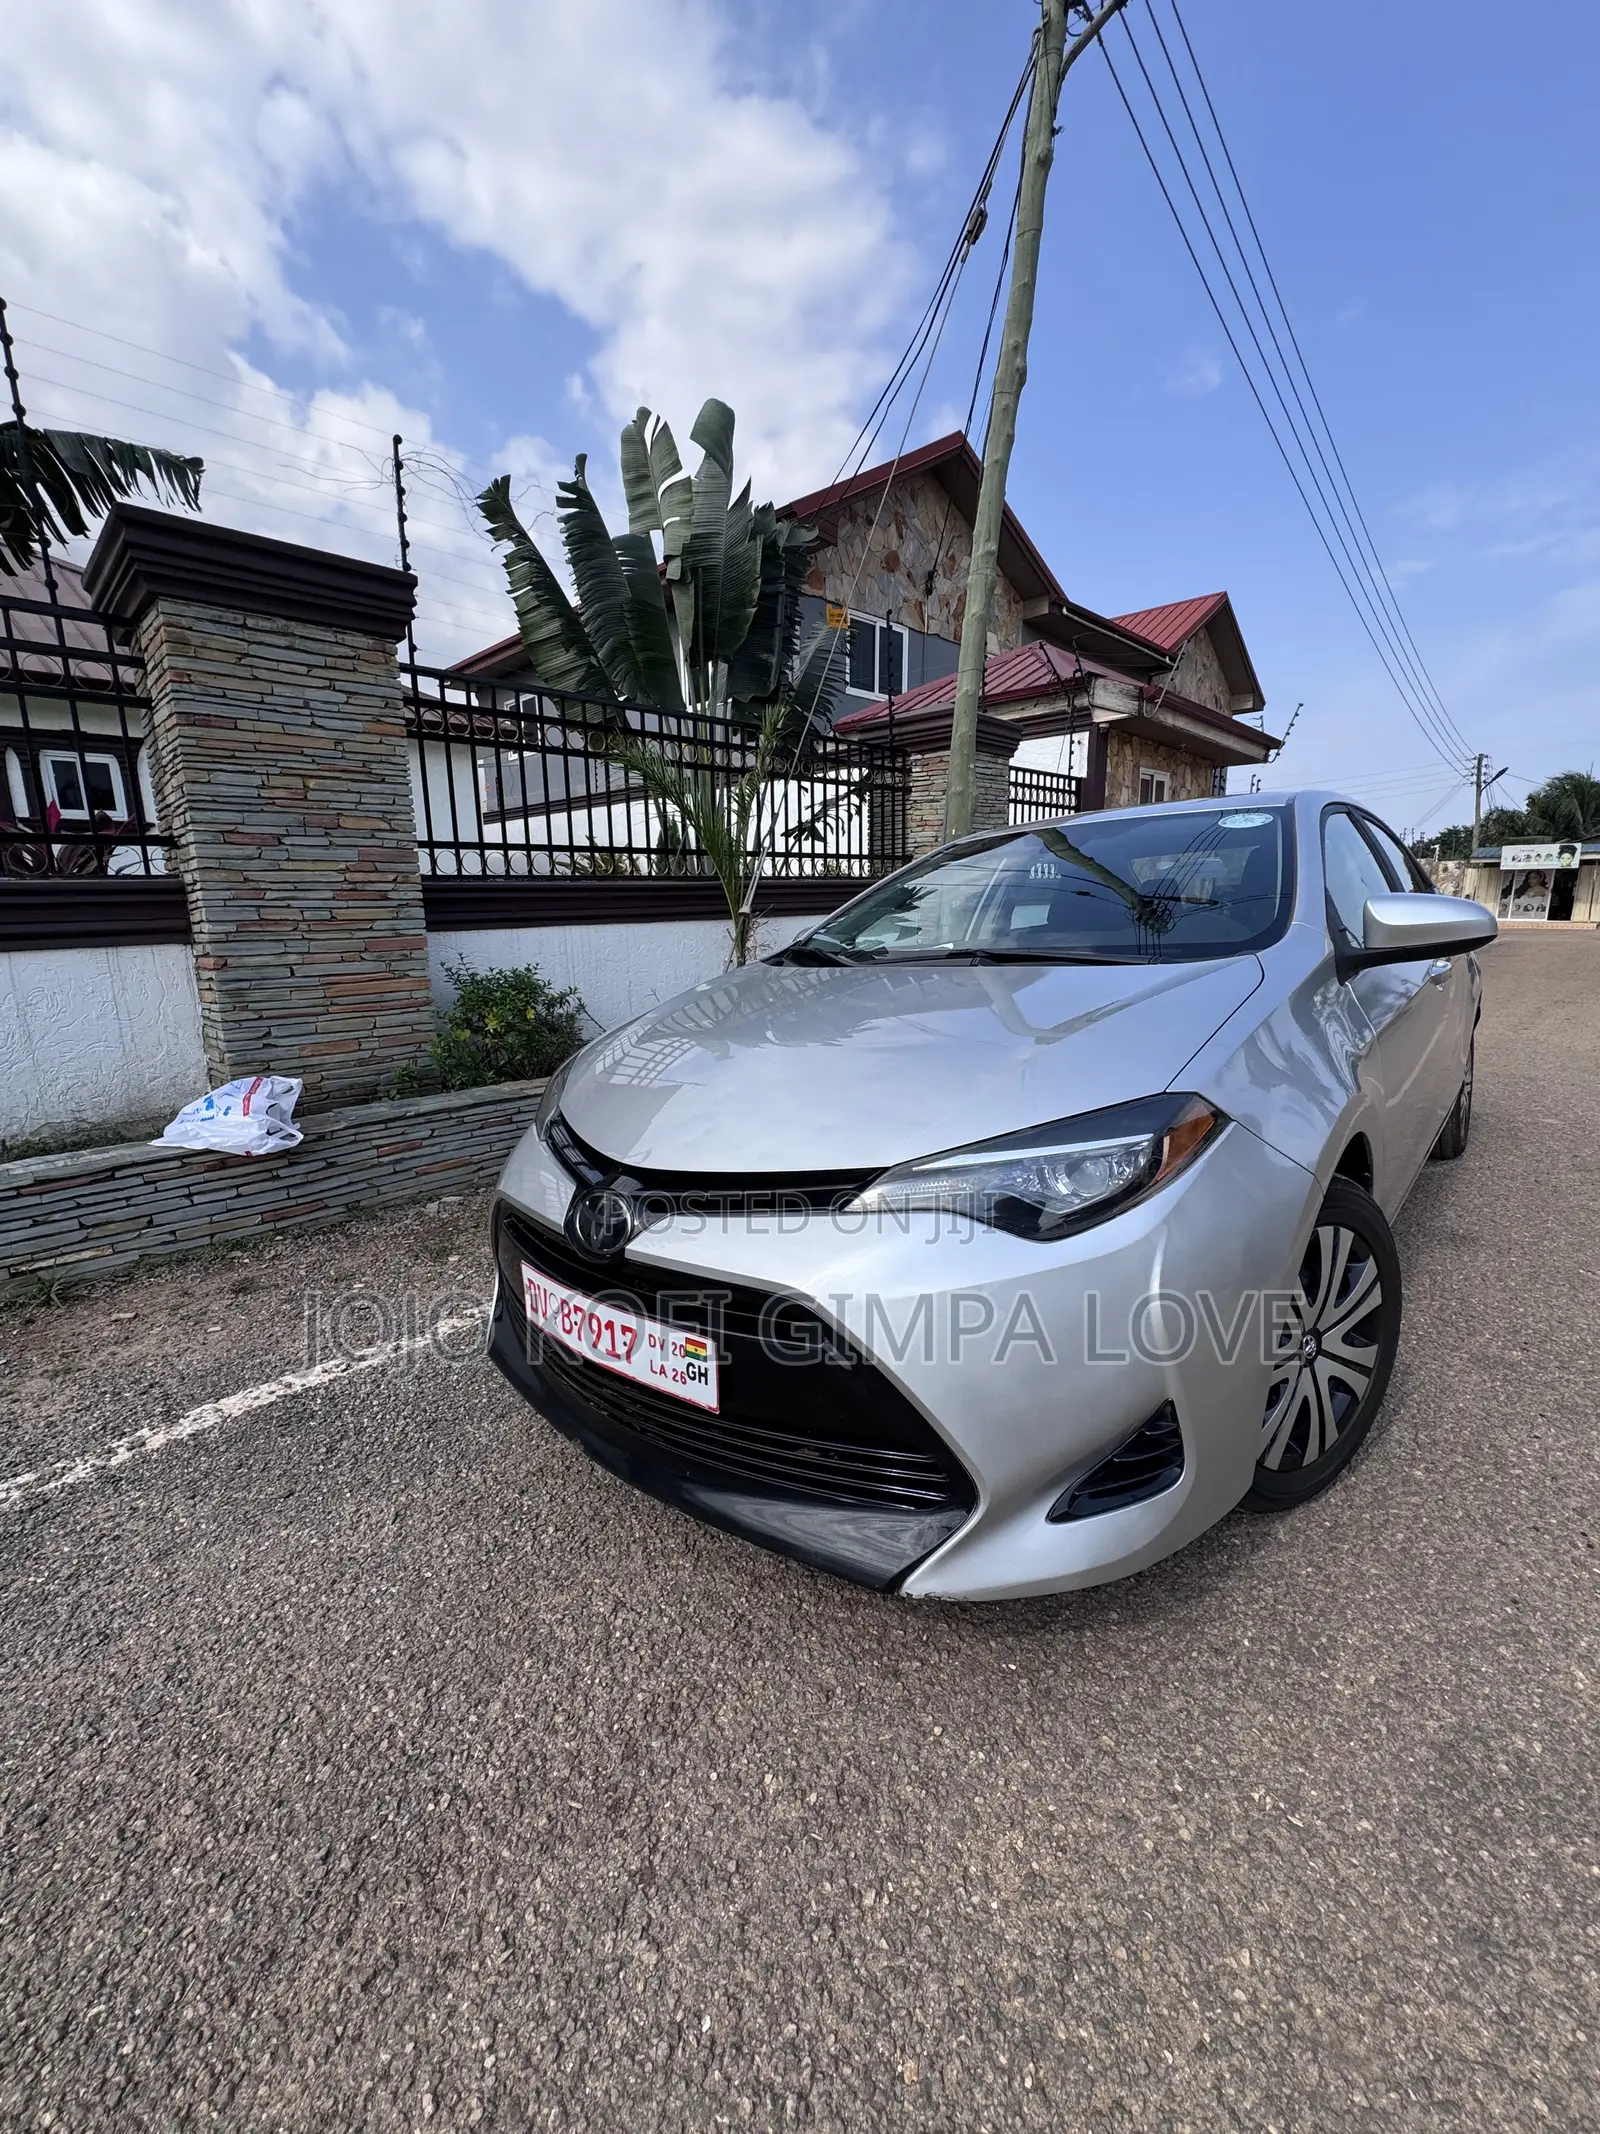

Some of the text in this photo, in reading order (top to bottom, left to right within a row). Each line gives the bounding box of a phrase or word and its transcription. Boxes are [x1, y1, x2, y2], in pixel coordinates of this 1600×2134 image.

[527, 1278, 548, 1320] DV
[648, 1333, 686, 1359] DV 20
[650, 1360, 687, 1386] LA 26
[686, 1362, 709, 1386] GH
